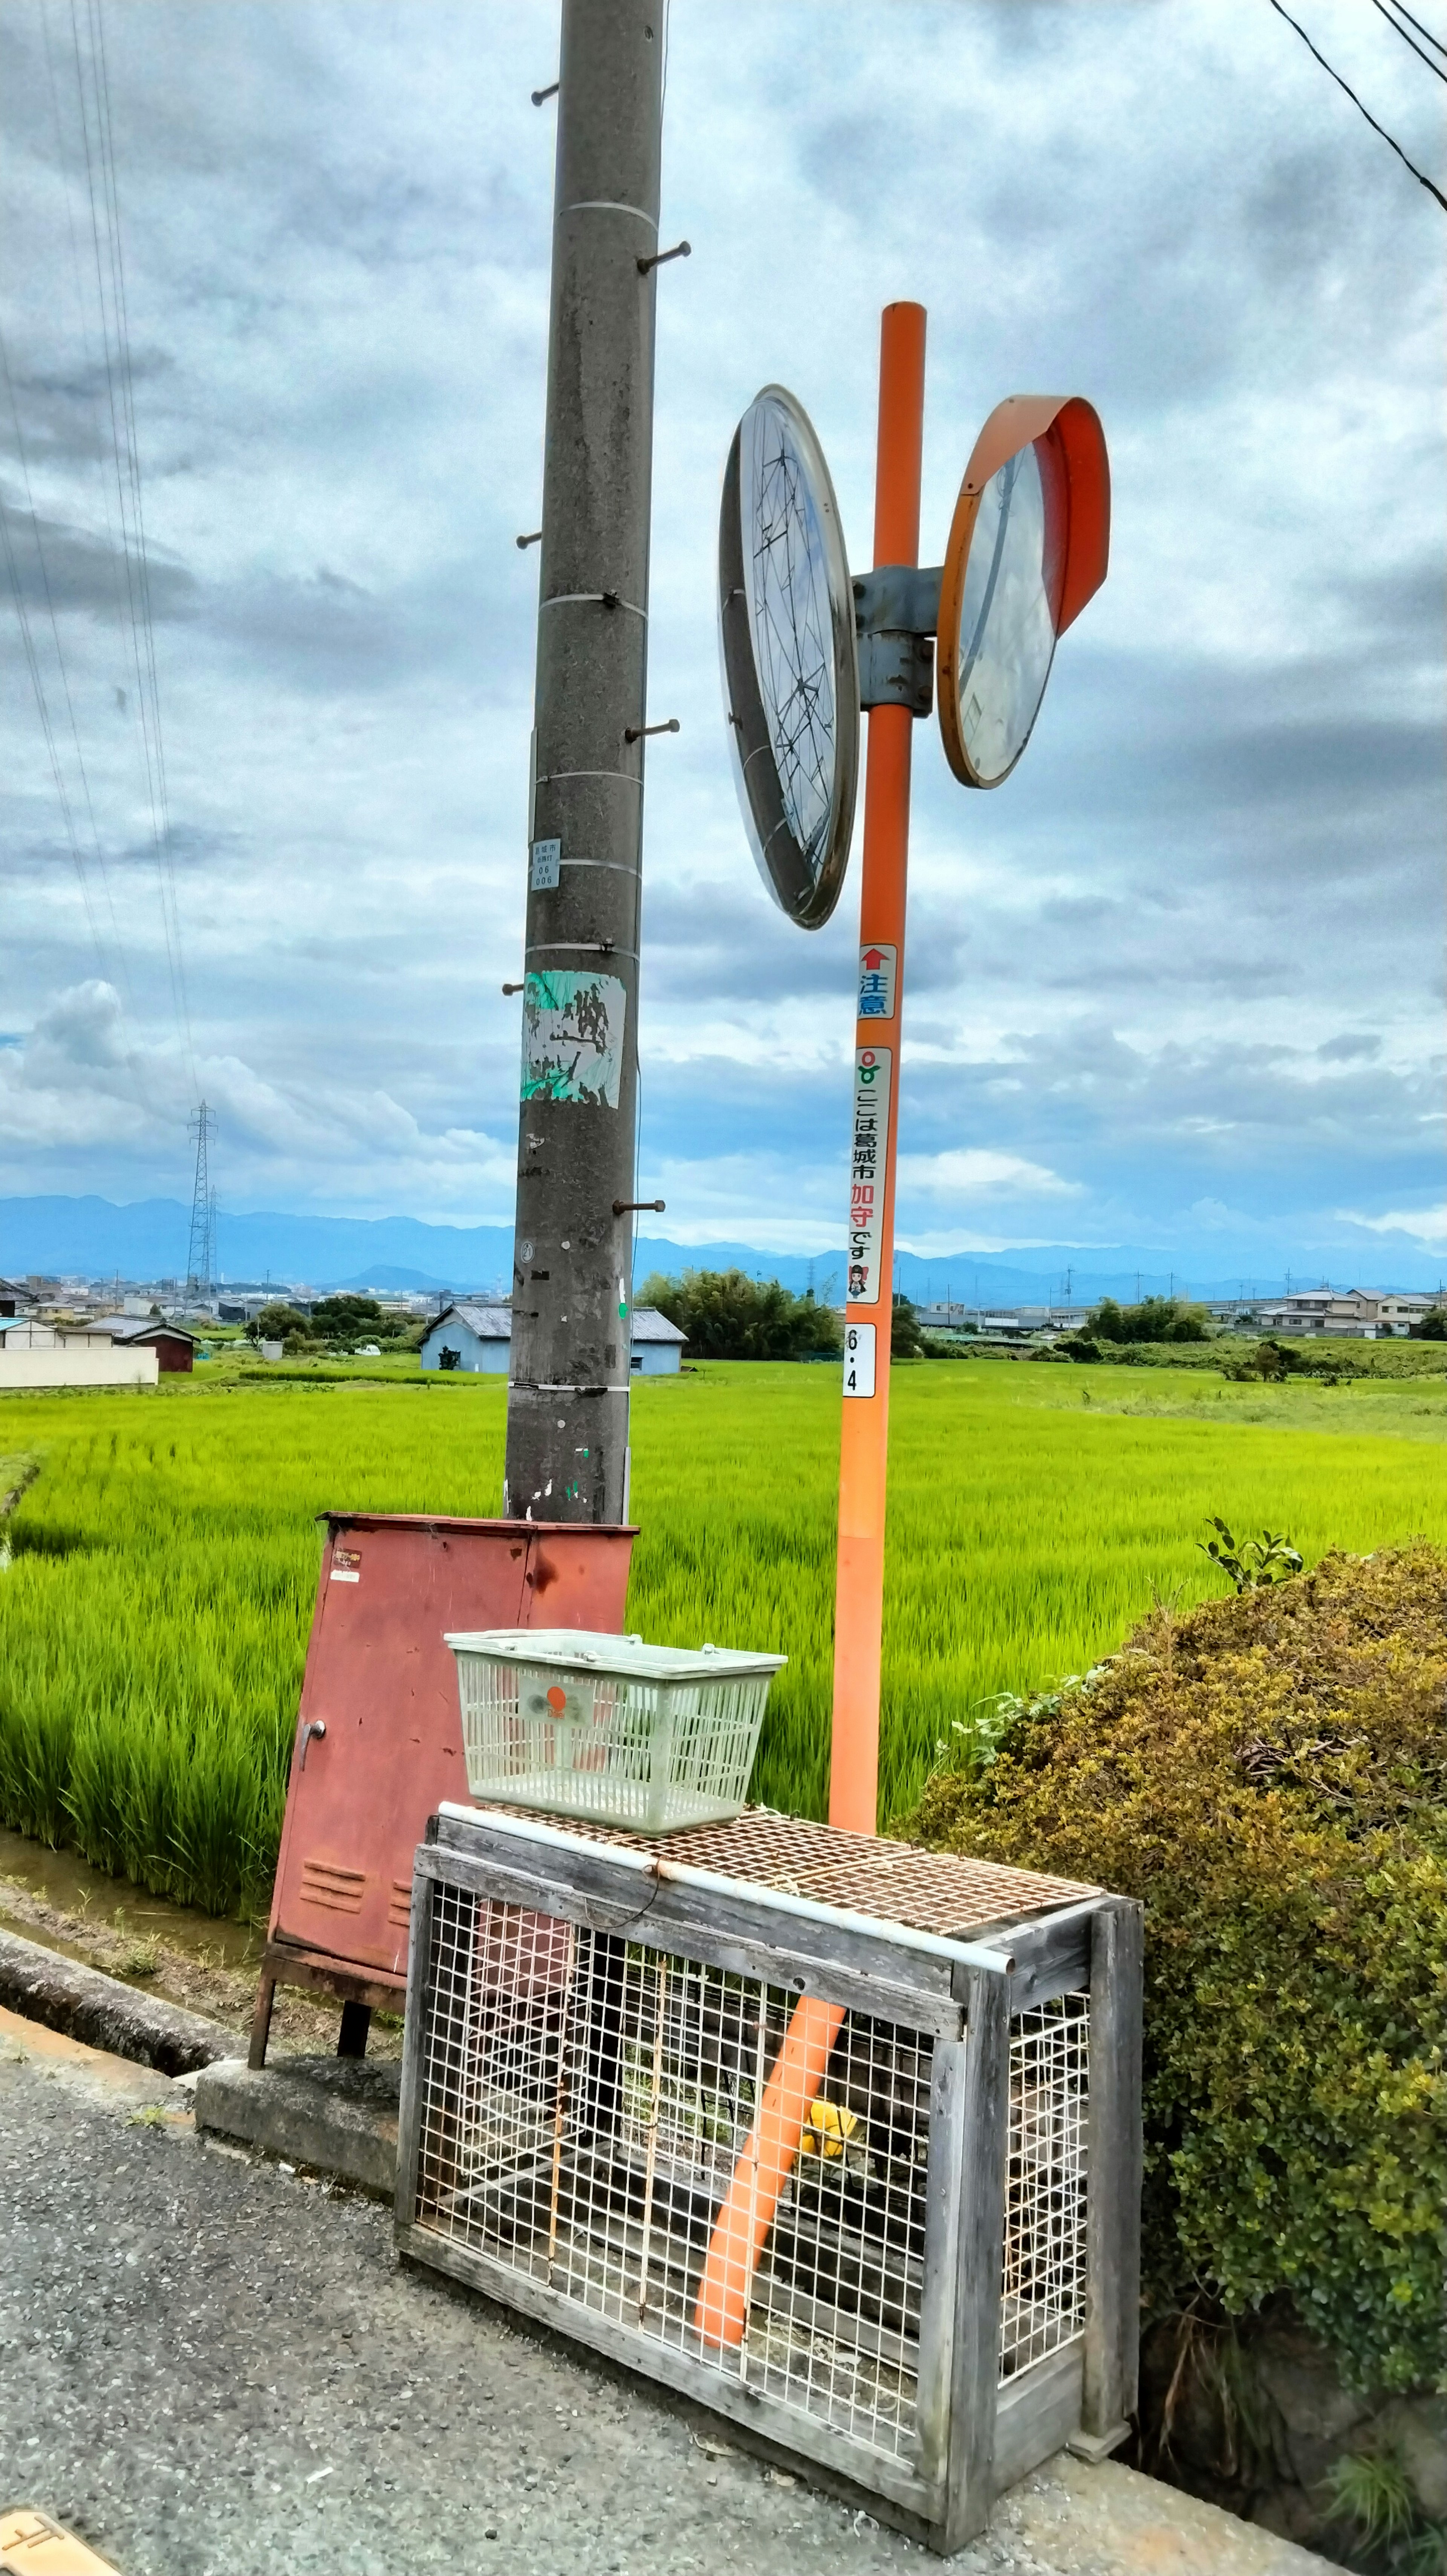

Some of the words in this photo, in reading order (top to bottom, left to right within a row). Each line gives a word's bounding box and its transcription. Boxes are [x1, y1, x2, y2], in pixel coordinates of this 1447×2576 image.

[539, 866, 549, 874] 06
[536, 876, 551, 885] 006
[859, 974, 888, 1016] 注意
[523, 1247, 531, 1257] 21
